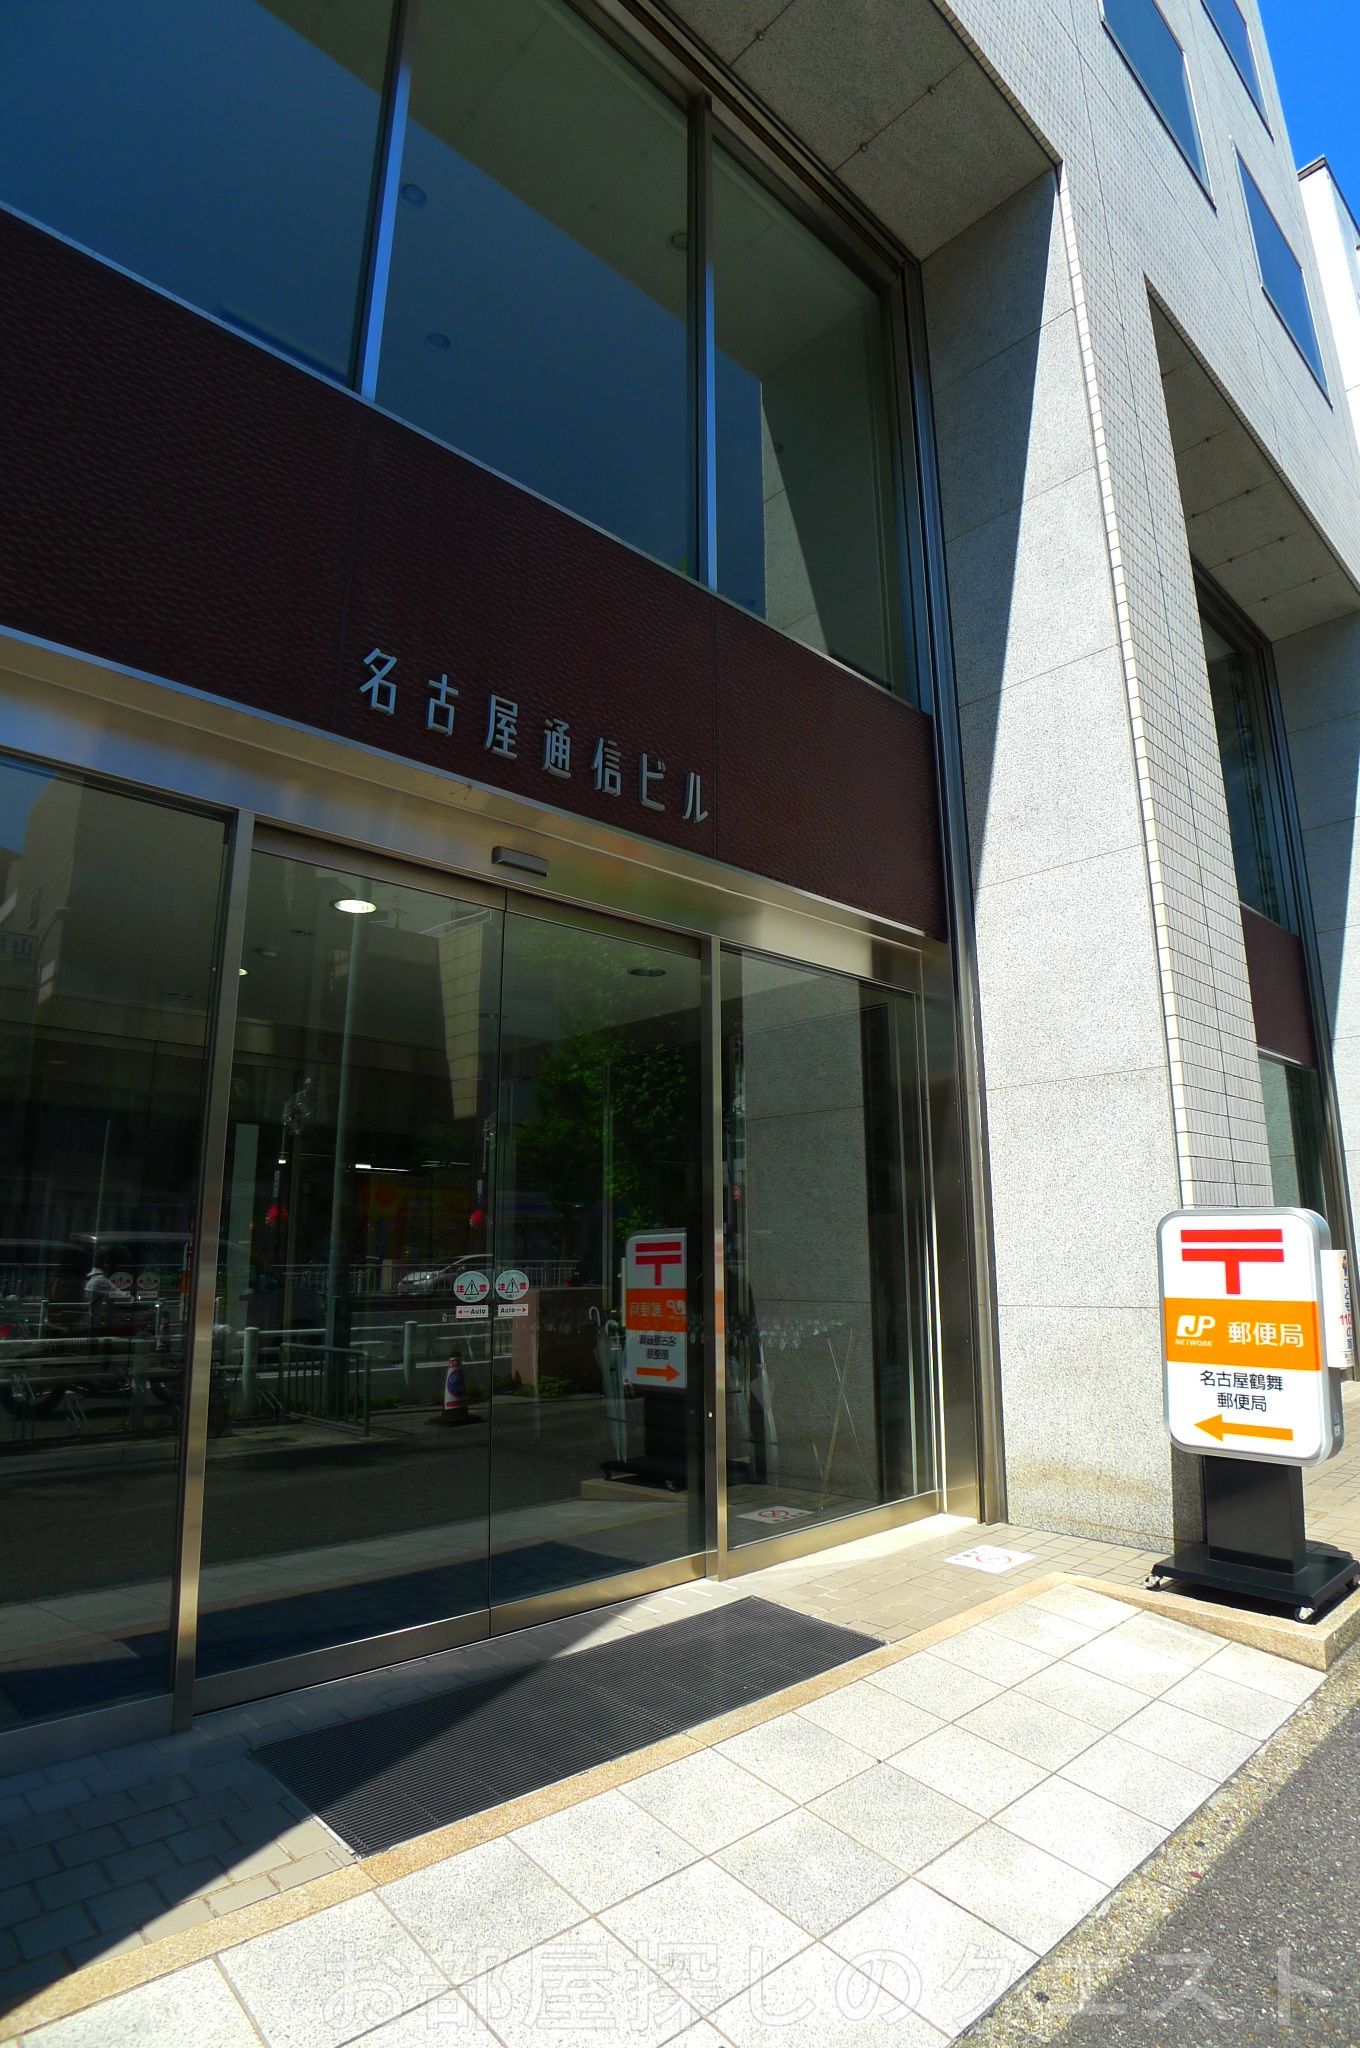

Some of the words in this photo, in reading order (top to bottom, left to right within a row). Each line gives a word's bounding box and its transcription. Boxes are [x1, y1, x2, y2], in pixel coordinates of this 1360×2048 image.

[360, 648, 708, 823] 名古屋通信ビル
[1176, 1314, 1216, 1338] JP
[1228, 1321, 1304, 1348] 郵便局
[1175, 1338, 1213, 1347] NETWORK
[1200, 1370, 1284, 1391] 名古屋鶴舞
[1217, 1392, 1267, 1412] 郵便局
